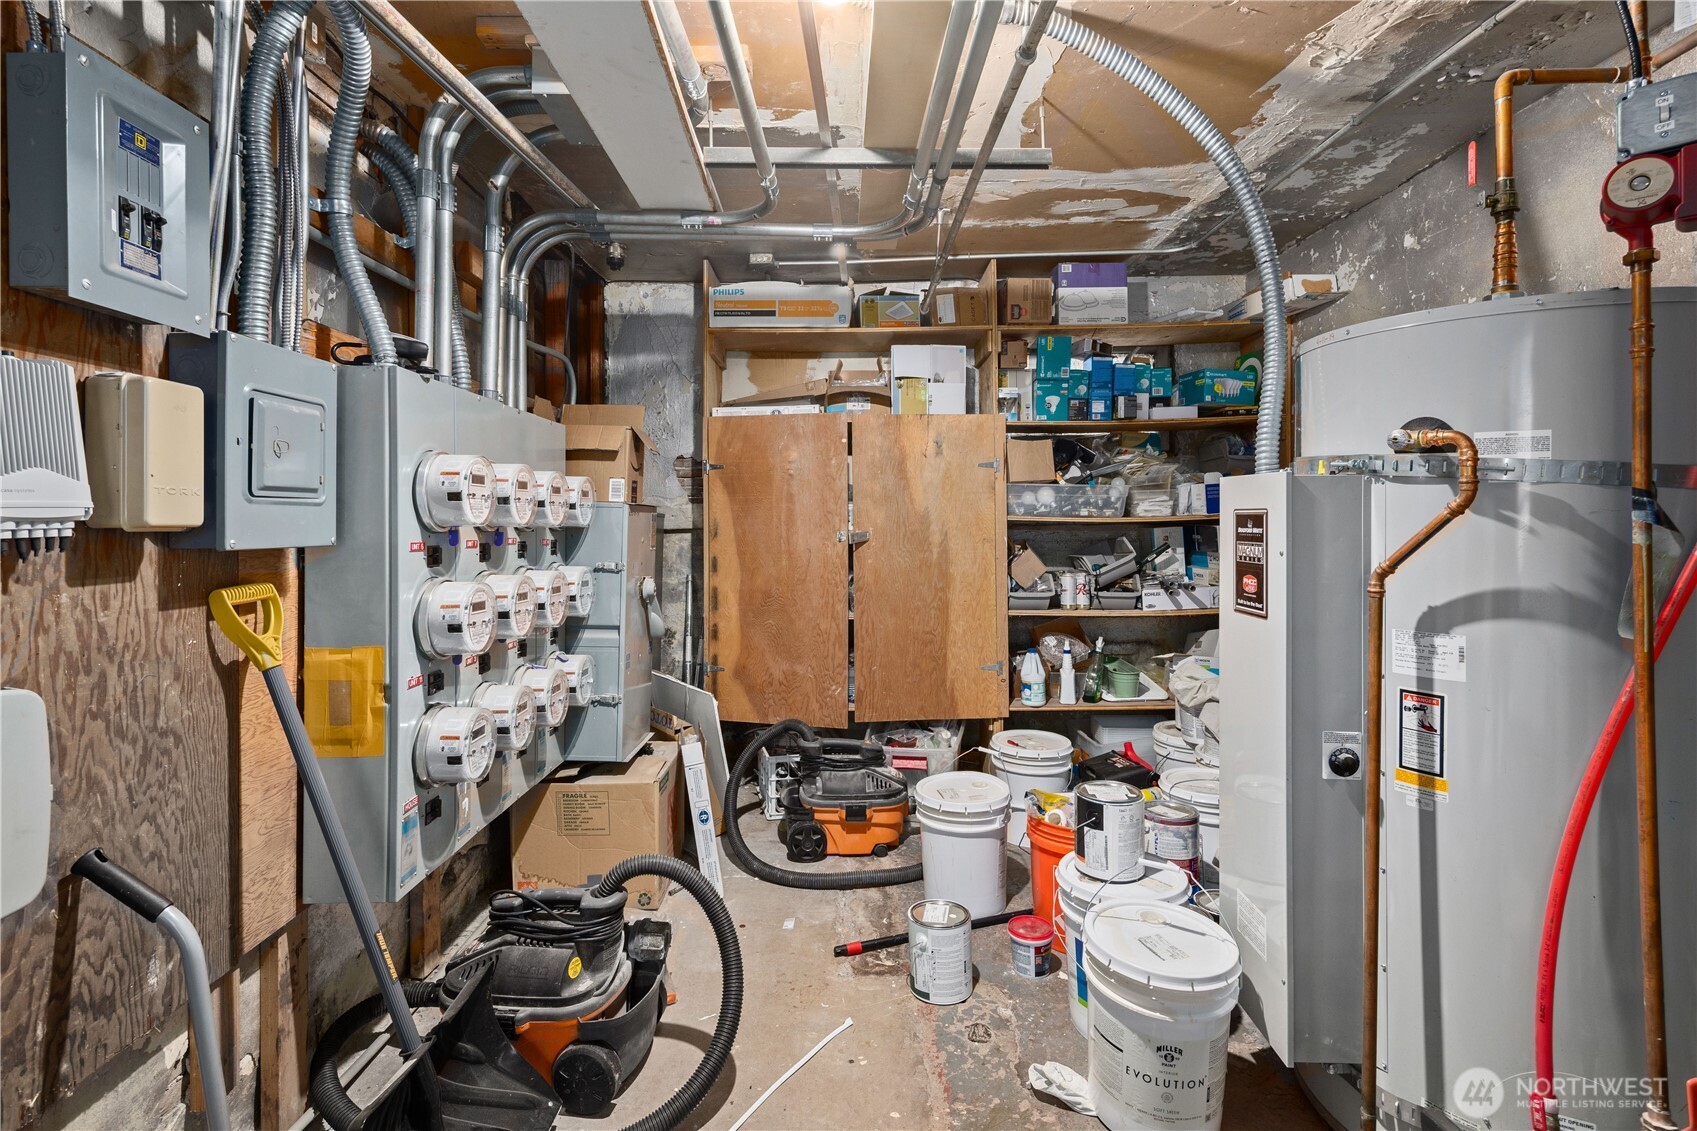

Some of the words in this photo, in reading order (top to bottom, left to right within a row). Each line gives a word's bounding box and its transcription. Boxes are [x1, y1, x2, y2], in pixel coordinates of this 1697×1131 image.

[1657, 97, 1669, 105] ON
[1656, 121, 1672, 131] OFF
[713, 288, 745, 296] PHILIPS
[153, 486, 201, 497] TORK
[1413, 696, 1437, 705] DANGER
[376, 932, 388, 951] TRUE
[508, 964, 550, 977] RIDGID
[1156, 1045, 1183, 1057] MILLER
[1125, 1065, 1205, 1090] EVOLUTION
[1567, 1119, 1594, 1130] OPENING
